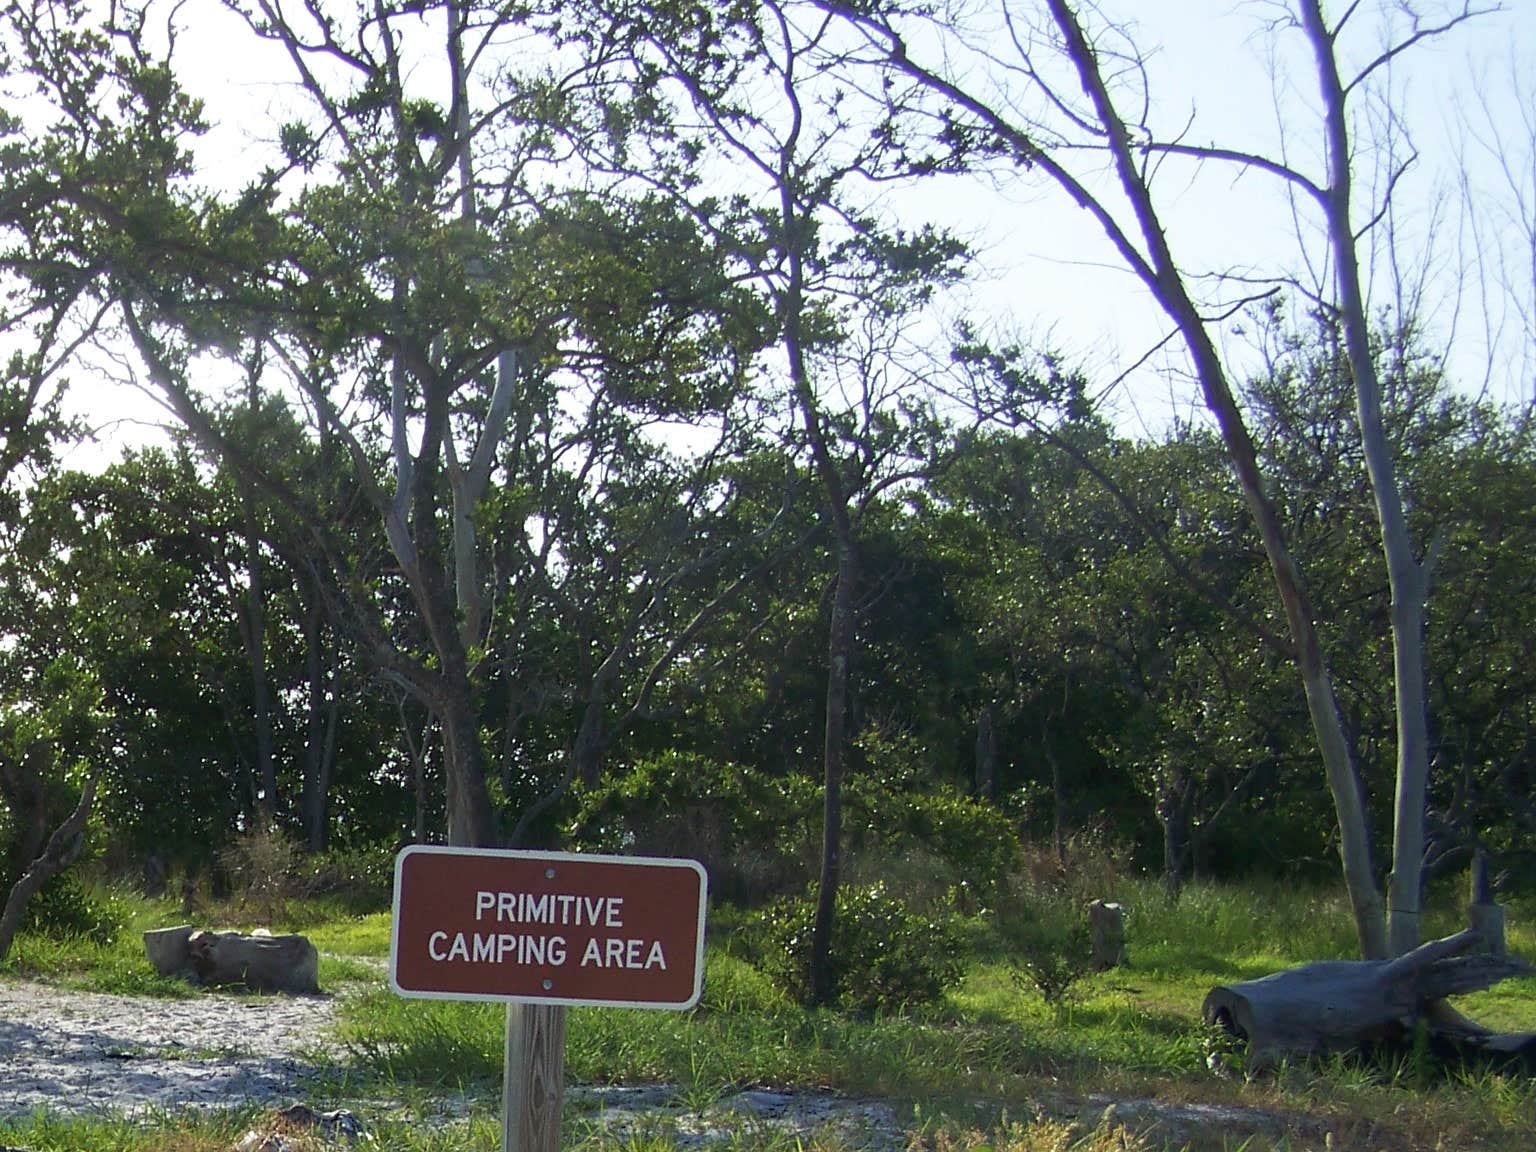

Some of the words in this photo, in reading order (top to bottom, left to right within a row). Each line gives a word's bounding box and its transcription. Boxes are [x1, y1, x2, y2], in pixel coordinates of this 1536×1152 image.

[476, 891, 623, 927] PRIMITIVE
[428, 931, 566, 966] CAMPING
[580, 938, 666, 970] AREA
